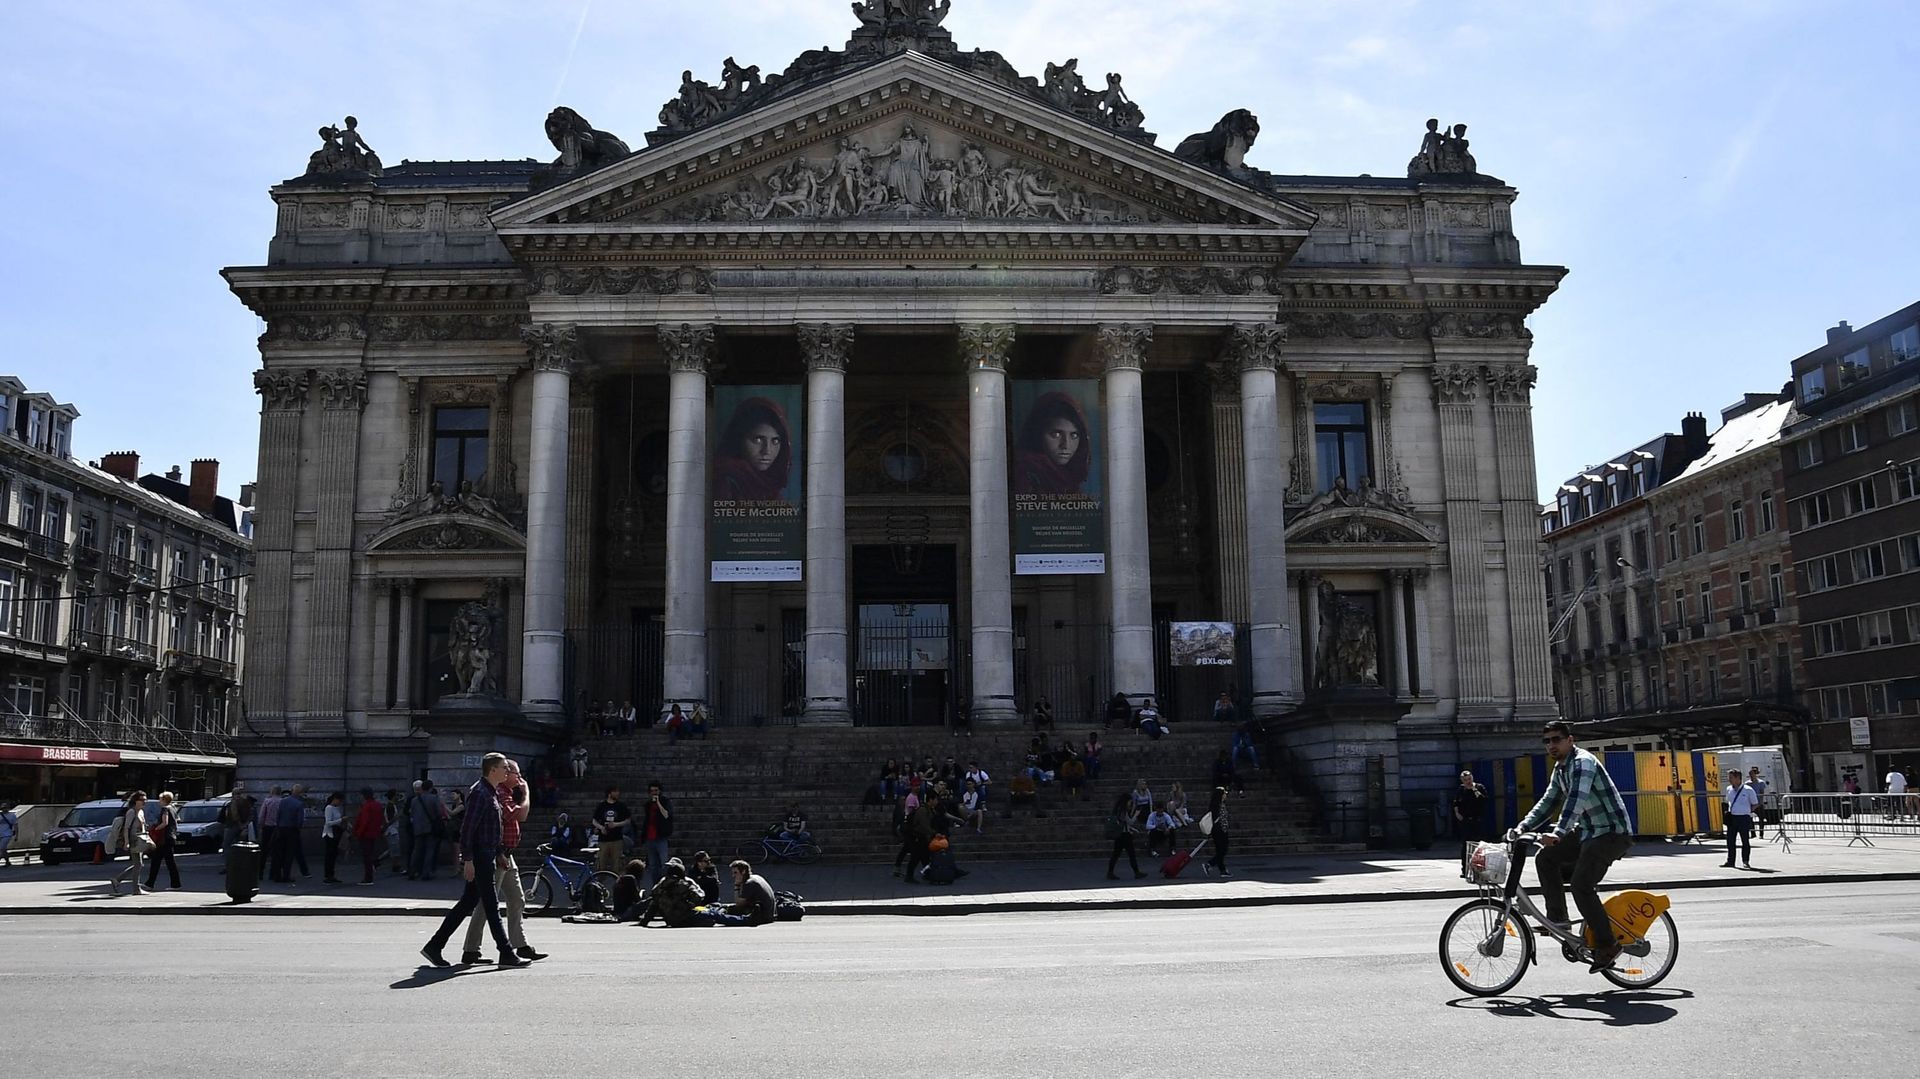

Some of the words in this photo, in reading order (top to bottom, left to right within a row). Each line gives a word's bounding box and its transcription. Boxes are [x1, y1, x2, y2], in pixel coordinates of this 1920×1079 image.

[1016, 502, 1048, 510] STEVE
[1050, 501, 1100, 510] McCURRY
[714, 508, 746, 517] STEVE
[749, 507, 799, 516] McCURRY
[1196, 657, 1233, 665] #BXLove
[42, 748, 89, 760] BRASSERIE
